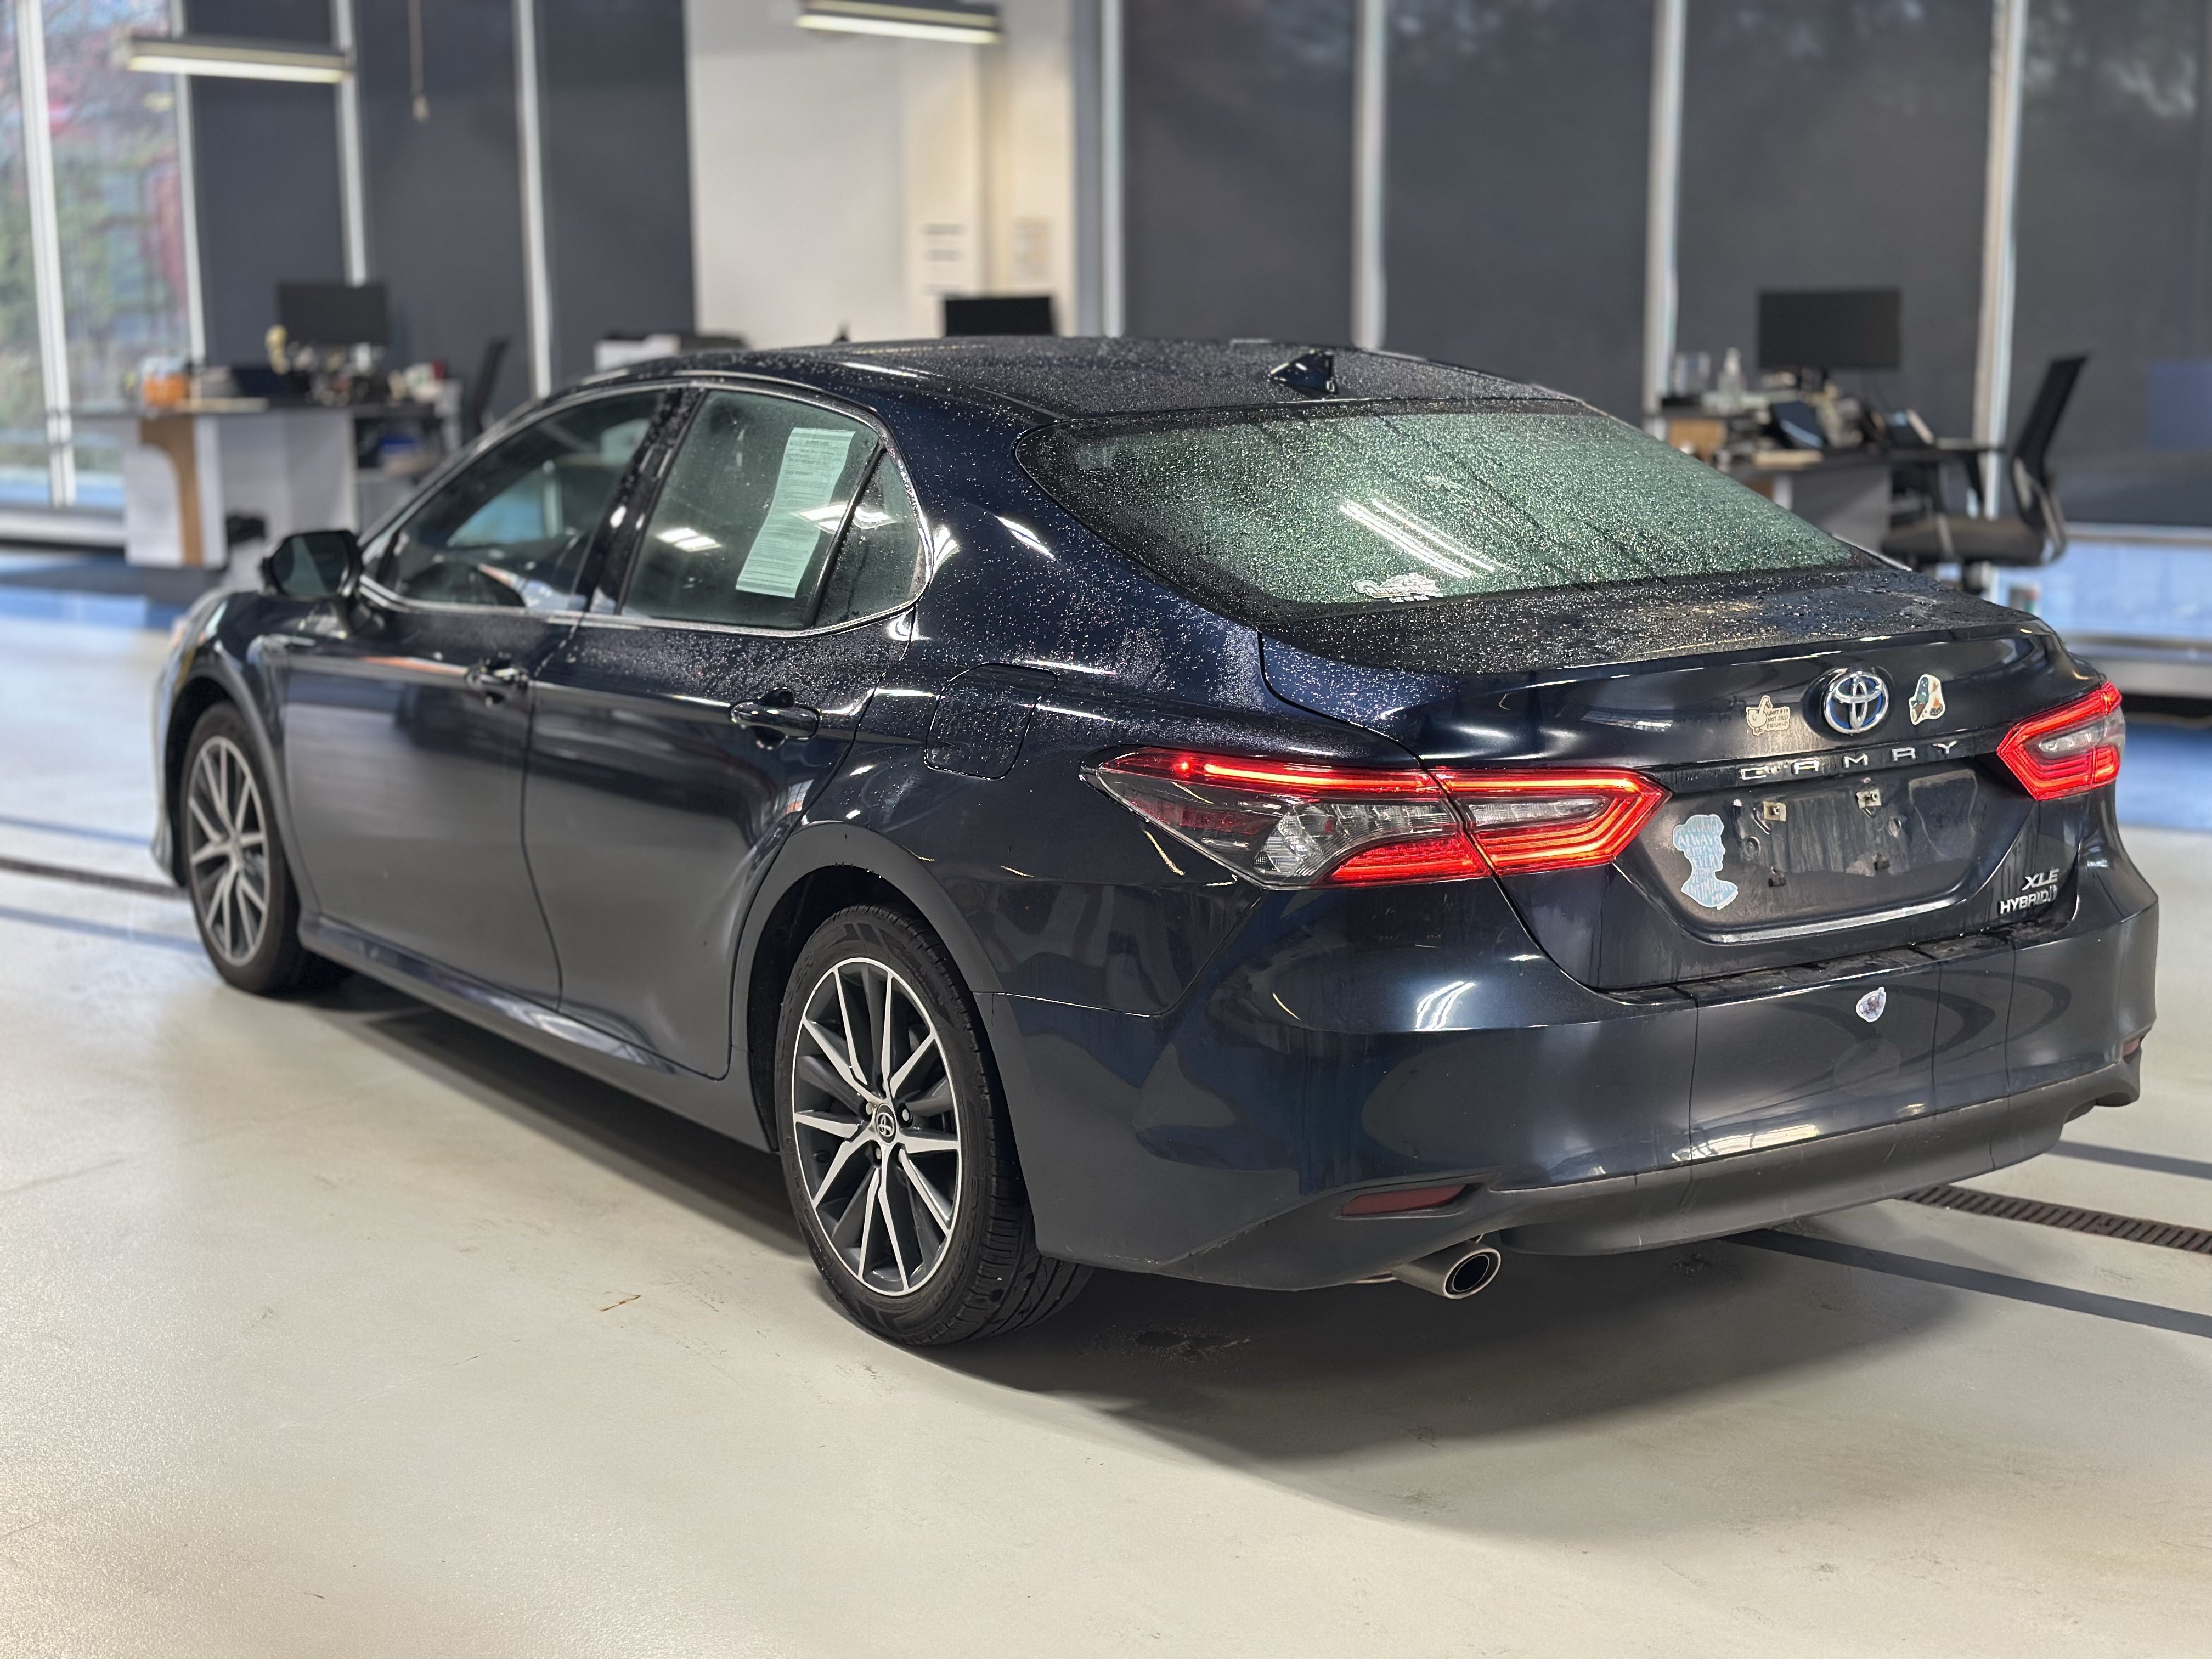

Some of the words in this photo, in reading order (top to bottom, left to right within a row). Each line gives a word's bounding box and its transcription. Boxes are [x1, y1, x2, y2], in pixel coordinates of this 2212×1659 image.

[1741, 740, 1958, 780] CAMRY
[1678, 833, 1721, 848] ALWAYS
[1692, 854, 1722, 869] EVERY
[2022, 868, 2059, 891] XLE
[2000, 889, 2049, 915] HYBRID
